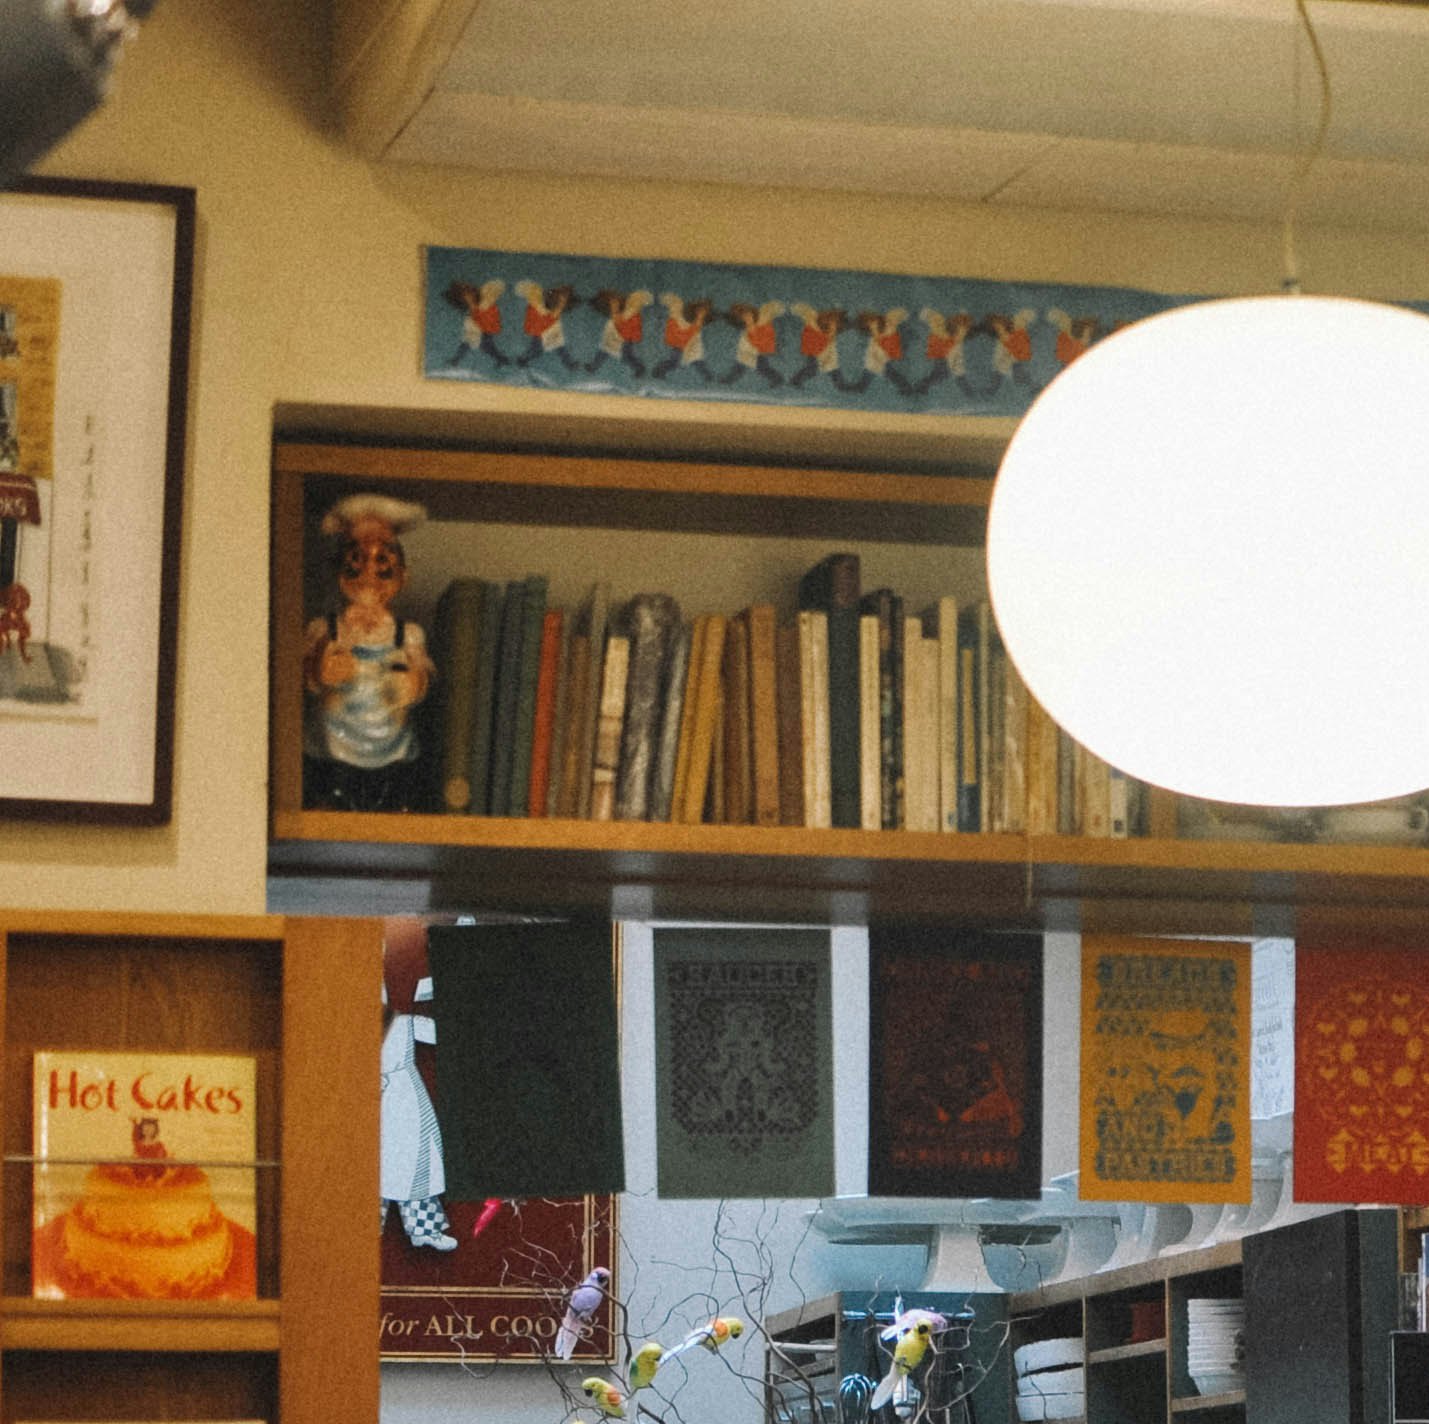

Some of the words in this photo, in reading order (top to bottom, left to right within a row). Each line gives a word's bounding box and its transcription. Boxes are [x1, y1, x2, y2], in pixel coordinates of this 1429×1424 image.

[49, 1069, 117, 1113] Hot
[130, 1072, 244, 1115] Cakes
[379, 1312, 419, 1340] for
[424, 1314, 477, 1338] ALL
[489, 1314, 594, 1340] COOS
